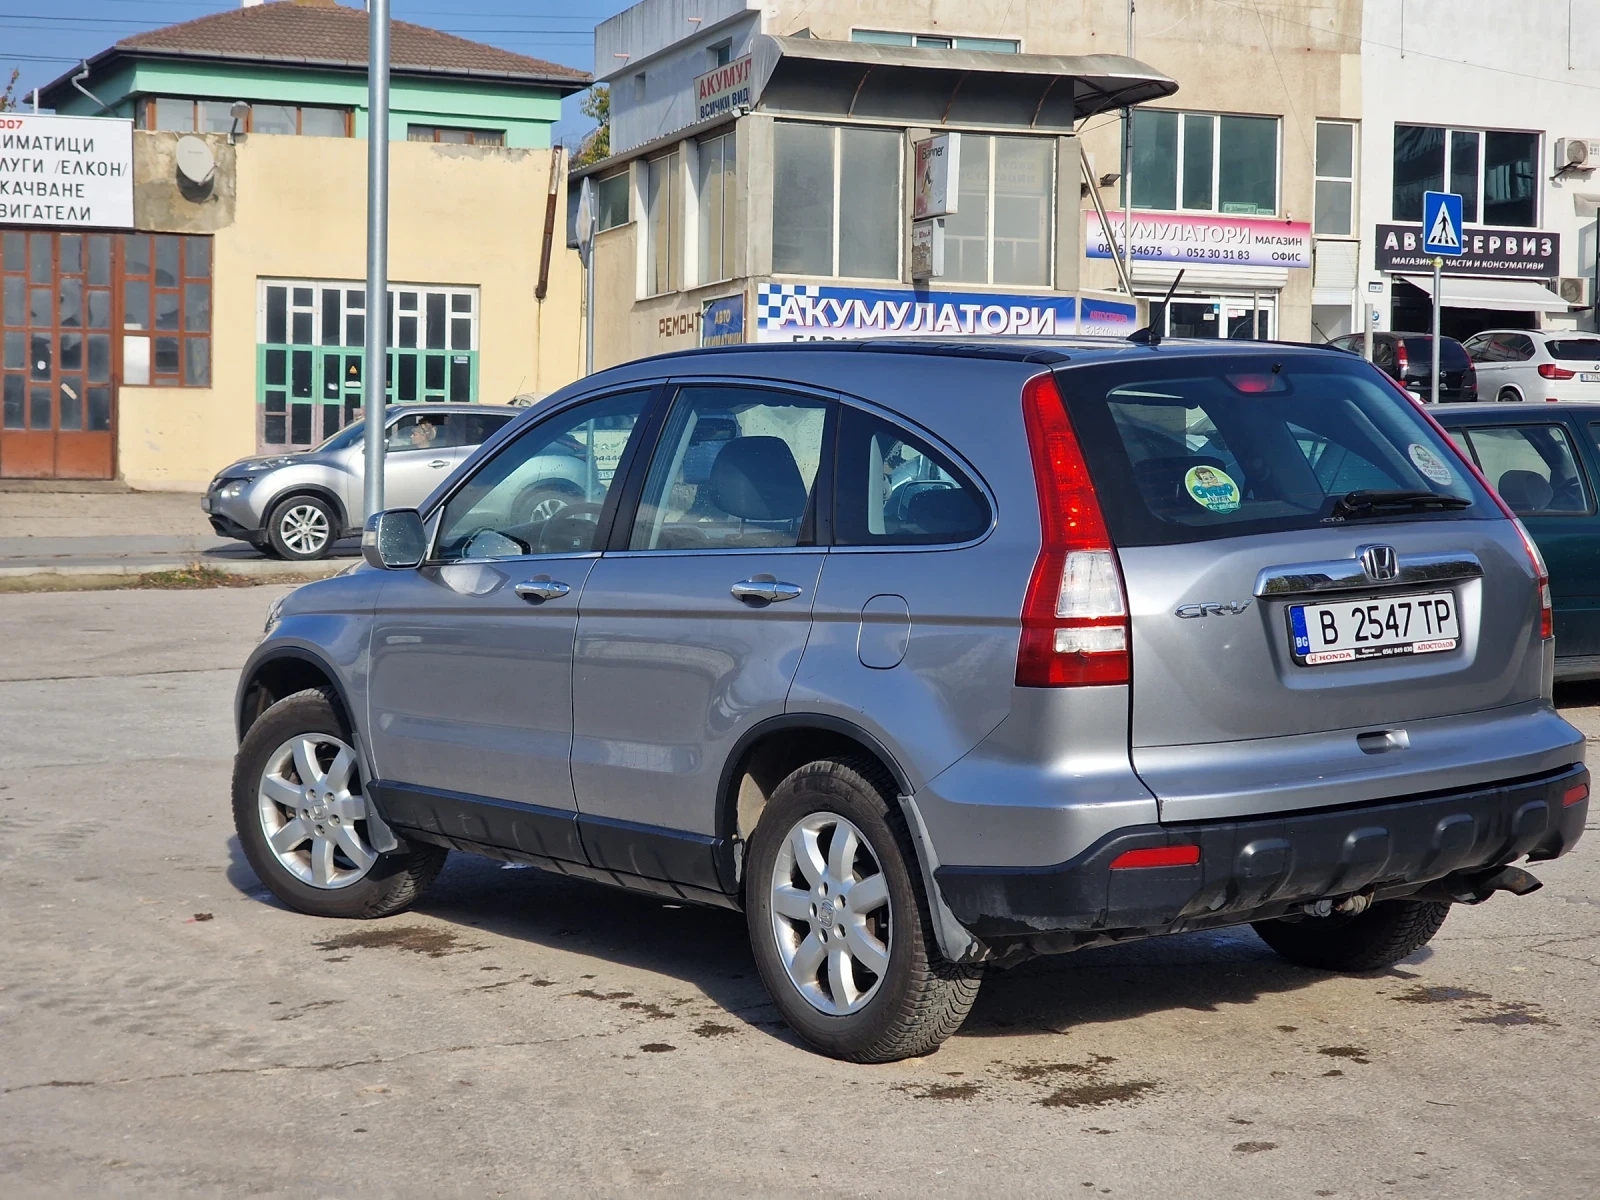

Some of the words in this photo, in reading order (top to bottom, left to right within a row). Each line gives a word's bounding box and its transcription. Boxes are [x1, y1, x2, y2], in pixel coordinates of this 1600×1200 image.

[732, 87, 751, 106] ВИД
[0, 134, 94, 154] ИМАТИЦИ
[922, 145, 944, 160] Banner
[54, 159, 128, 177] /ЕЛКОН/
[0, 180, 85, 198] КАЧВАНЕ
[0, 203, 91, 221] ВИГАТЕЛИ
[1255, 235, 1303, 246] МАГАЗИН
[1384, 231, 1552, 256] АВСЕРВИЗ
[1098, 243, 1163, 256] 08554675
[1186, 247, 1205, 258] 052
[1207, 249, 1221, 258] 30
[1222, 249, 1235, 260] 31
[1237, 250, 1250, 260] 83
[1271, 251, 1301, 261] ОФИС
[1445, 258, 1472, 267] ЧАСТИ
[1473, 259, 1481, 268] И
[1481, 260, 1544, 271] КОНСУМАТИВИ
[658, 311, 701, 338] РЕМОНТ
[714, 309, 731, 325] АВТО
[779, 295, 1057, 336] АКУМУЛАТОРИ
[1174, 599, 1253, 619] CR-V
[1319, 610, 1339, 645] B
[1351, 602, 1412, 642] 2547
[1417, 599, 1451, 635] TP
[1295, 636, 1308, 648] BG
[1417, 641, 1454, 651] АПОСТОЛОВ
[1319, 652, 1352, 661] HONDA
